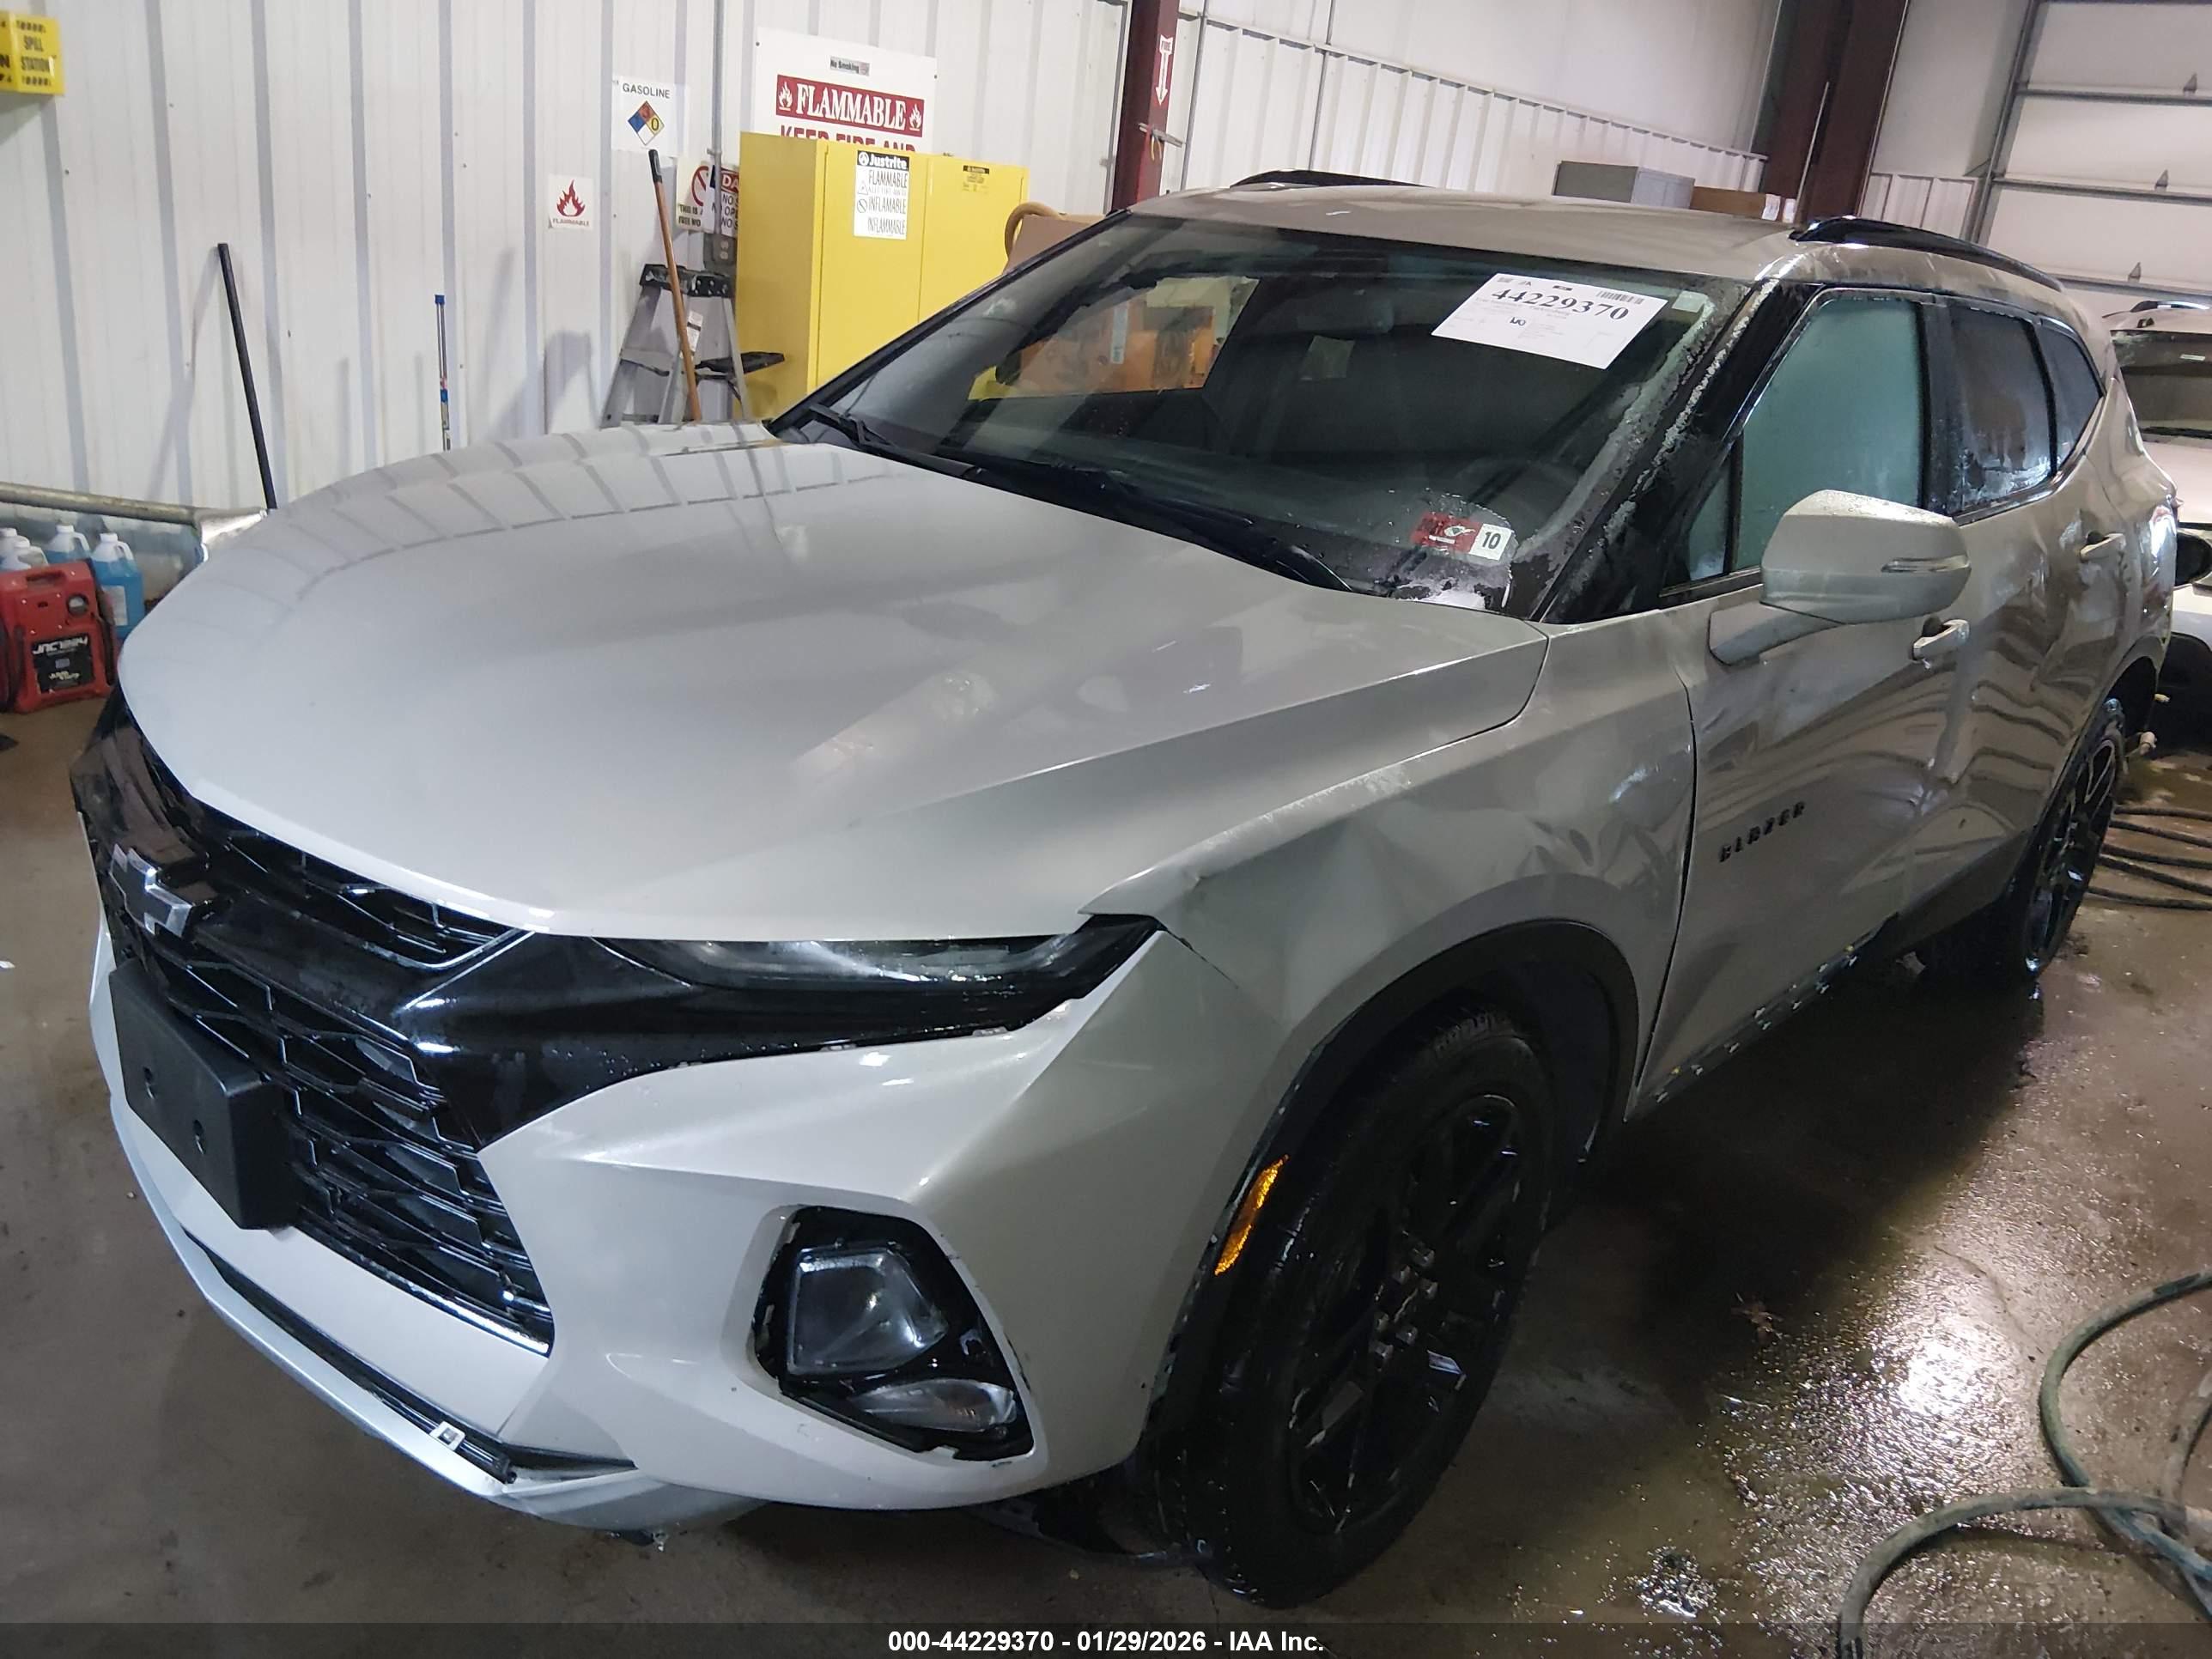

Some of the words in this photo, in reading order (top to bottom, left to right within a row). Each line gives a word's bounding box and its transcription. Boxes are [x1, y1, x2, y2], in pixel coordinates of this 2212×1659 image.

[622, 82, 670, 99] GASOLINE
[795, 82, 907, 131] FLAMMABLE
[868, 169, 908, 188] FLAMMABLE
[1492, 289, 1630, 320] 44229370
[1482, 532, 1501, 550] 10
[1718, 801, 1806, 863] BLAZER
